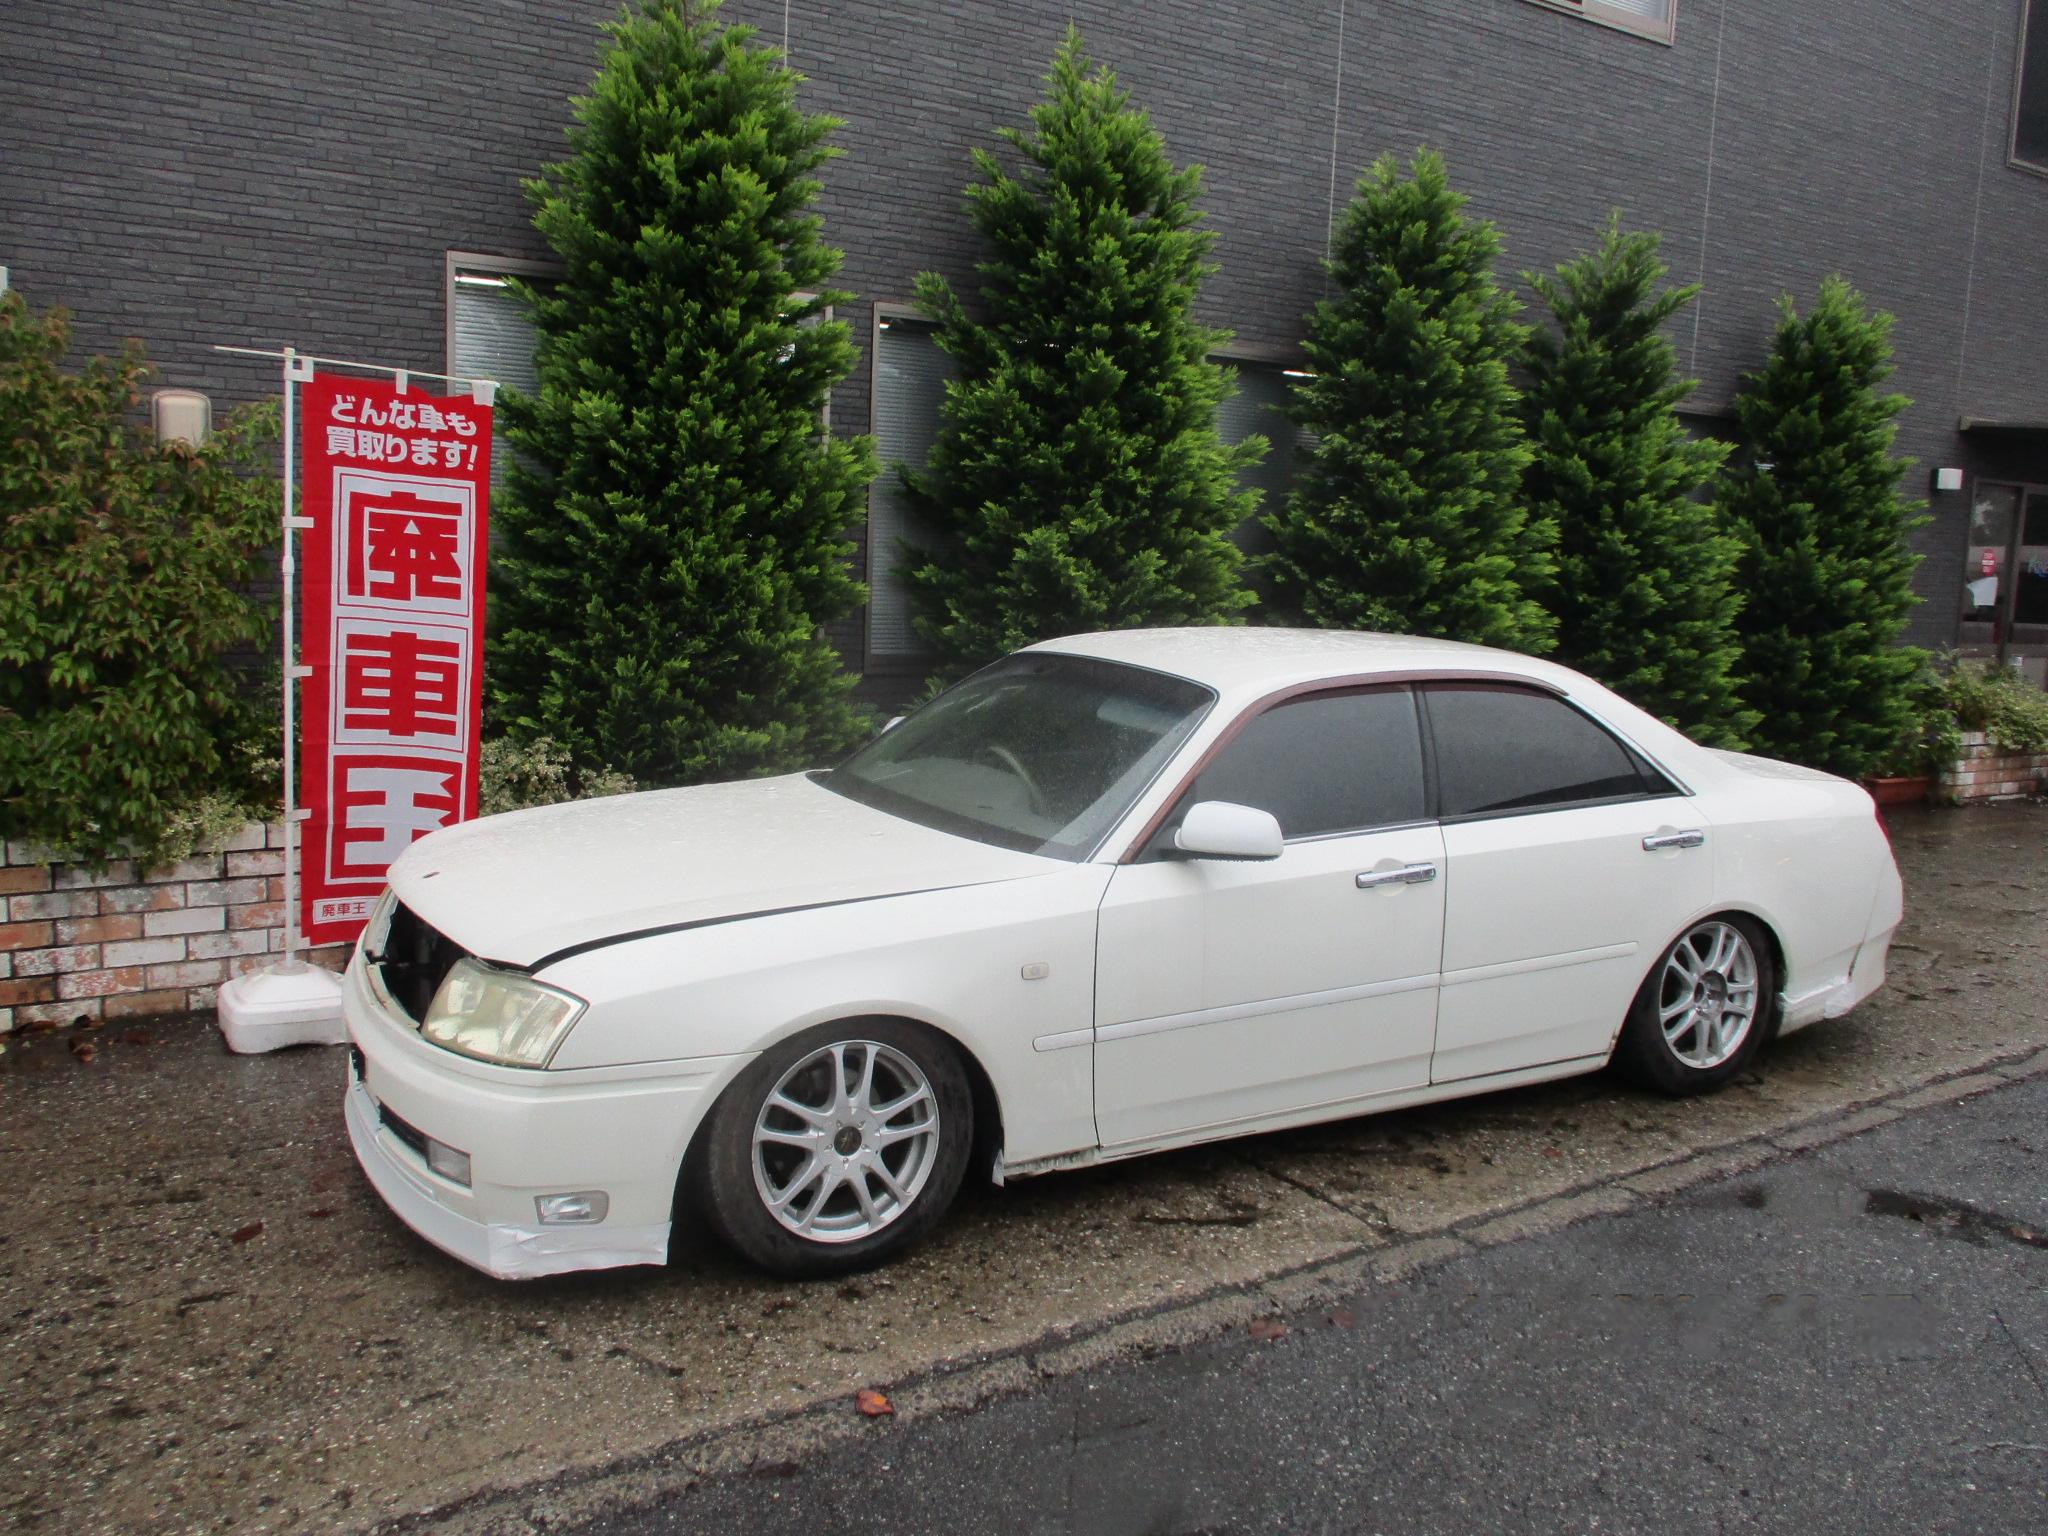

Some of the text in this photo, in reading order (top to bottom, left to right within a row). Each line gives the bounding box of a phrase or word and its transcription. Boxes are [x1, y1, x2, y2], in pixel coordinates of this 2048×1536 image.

[331, 394, 477, 436] どんな車も
[343, 490, 463, 866] 廃車王
[322, 901, 367, 917] 廃車王
